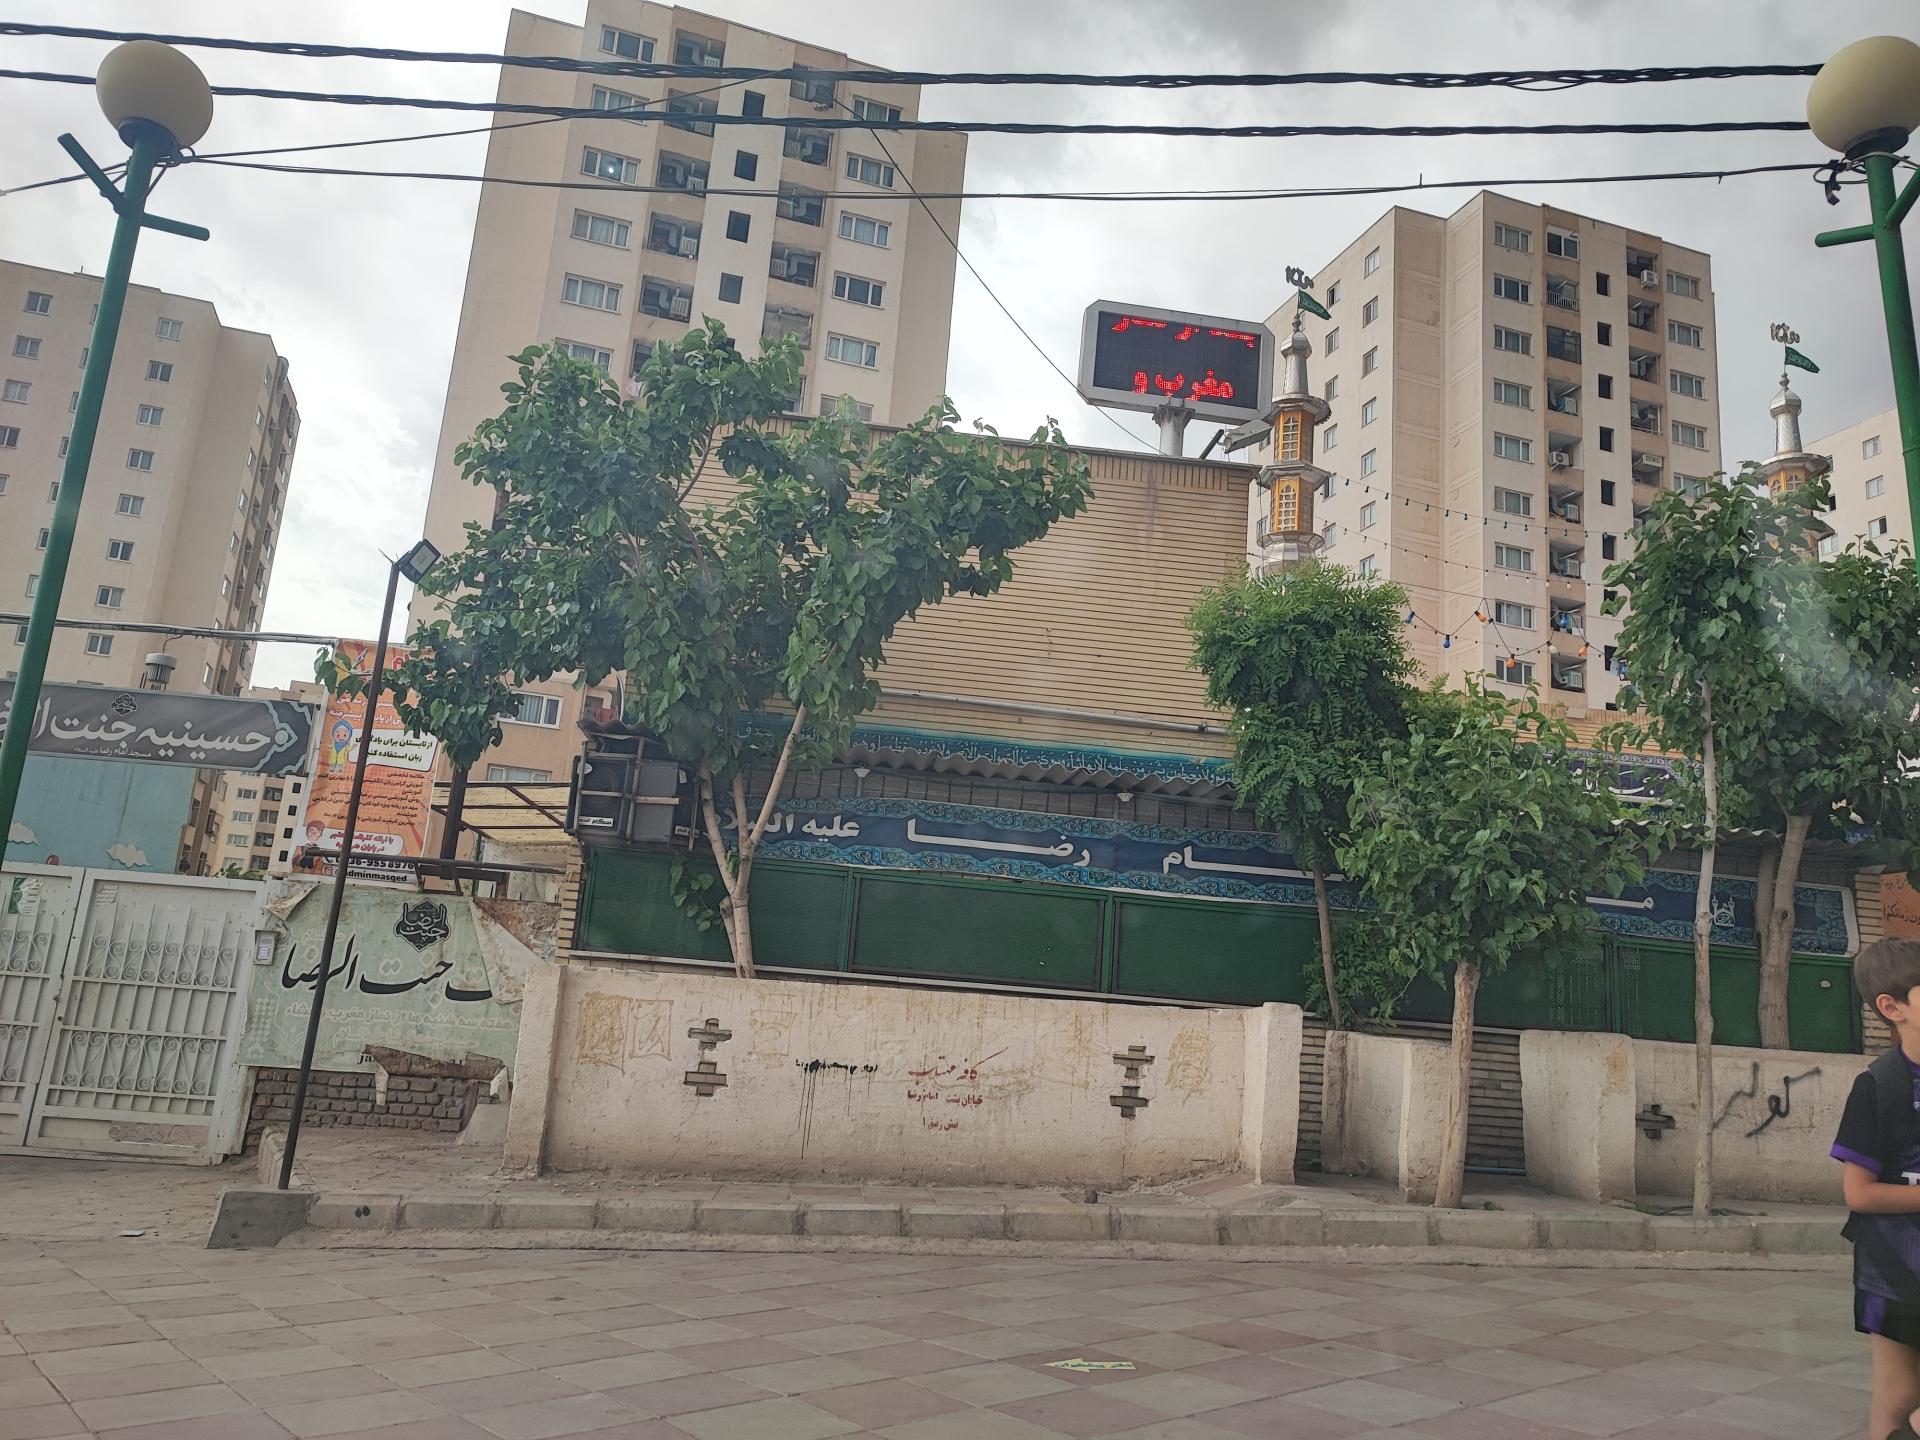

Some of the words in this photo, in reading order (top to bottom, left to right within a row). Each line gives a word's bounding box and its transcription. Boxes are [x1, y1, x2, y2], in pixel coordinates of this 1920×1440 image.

[50, 713, 137, 749] جنت
[136, 721, 271, 760] حسینیه
[383, 737, 399, 746] برای
[399, 739, 427, 748] تابستان
[379, 750, 408, 760] استفاده
[408, 752, 422, 762] زبان
[802, 815, 860, 842] علیه
